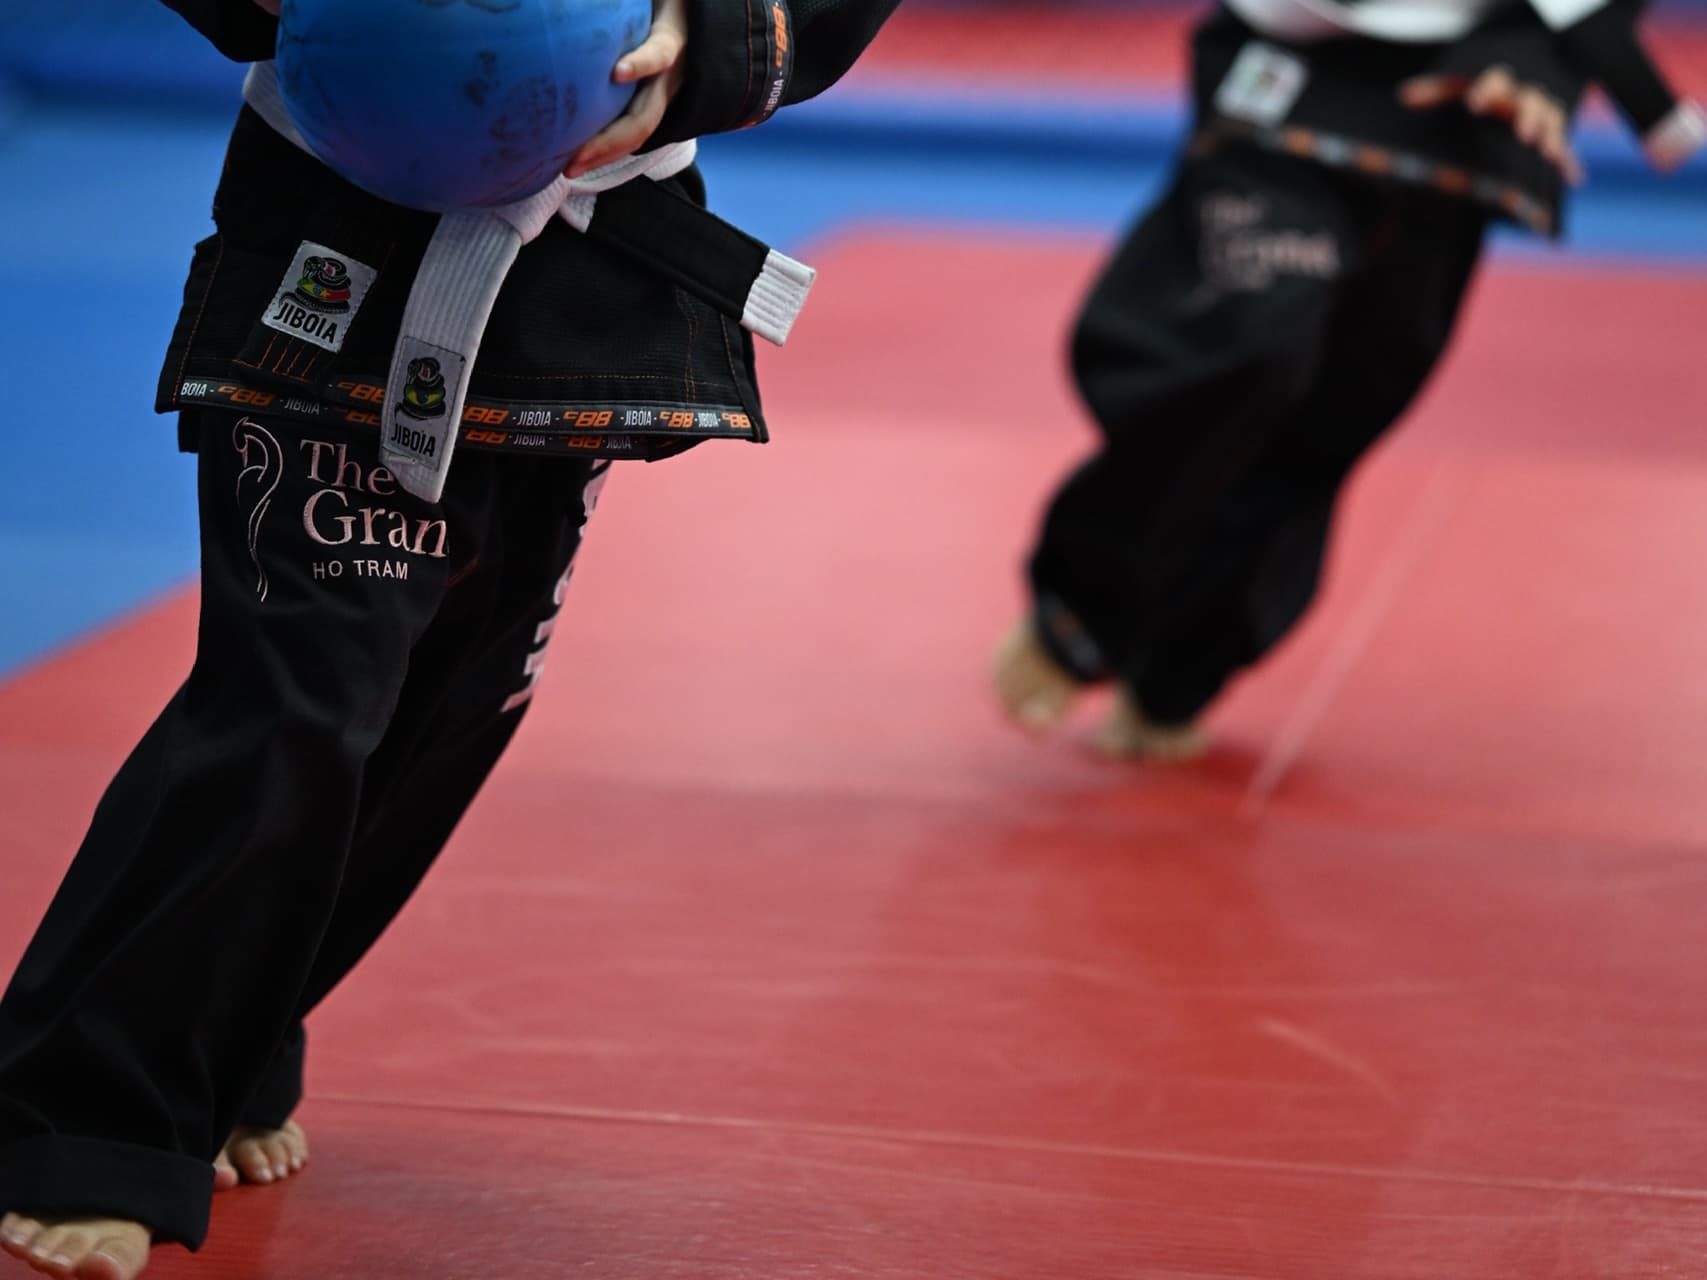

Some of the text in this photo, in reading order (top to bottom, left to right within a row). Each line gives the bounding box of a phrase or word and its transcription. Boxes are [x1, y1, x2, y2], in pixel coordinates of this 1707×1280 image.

[300, 439, 397, 496] The
[312, 559, 409, 581] HO TRAM
